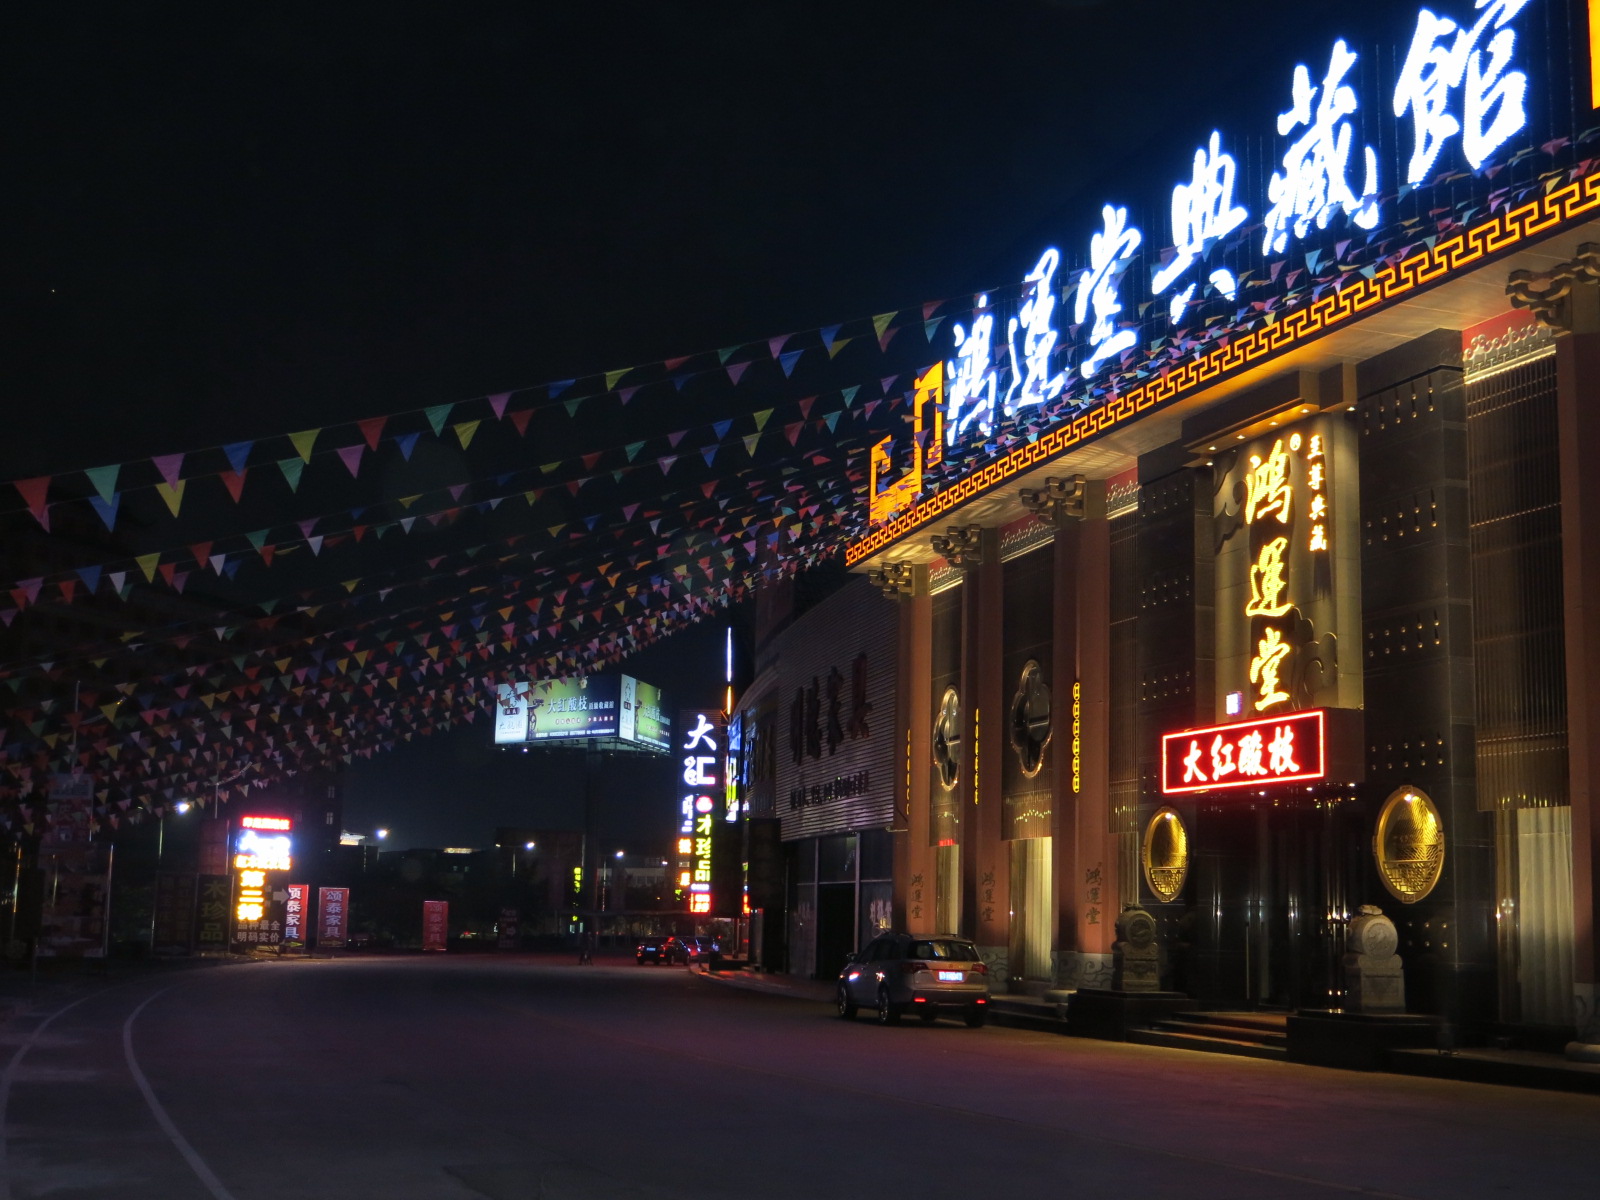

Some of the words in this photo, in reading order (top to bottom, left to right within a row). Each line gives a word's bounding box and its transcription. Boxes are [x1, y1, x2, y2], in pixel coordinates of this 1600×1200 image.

[1182, 725, 1300, 783] 大红酸枝
[237, 931, 280, 943] 明码实价
[324, 890, 343, 938] 颂泰家具
